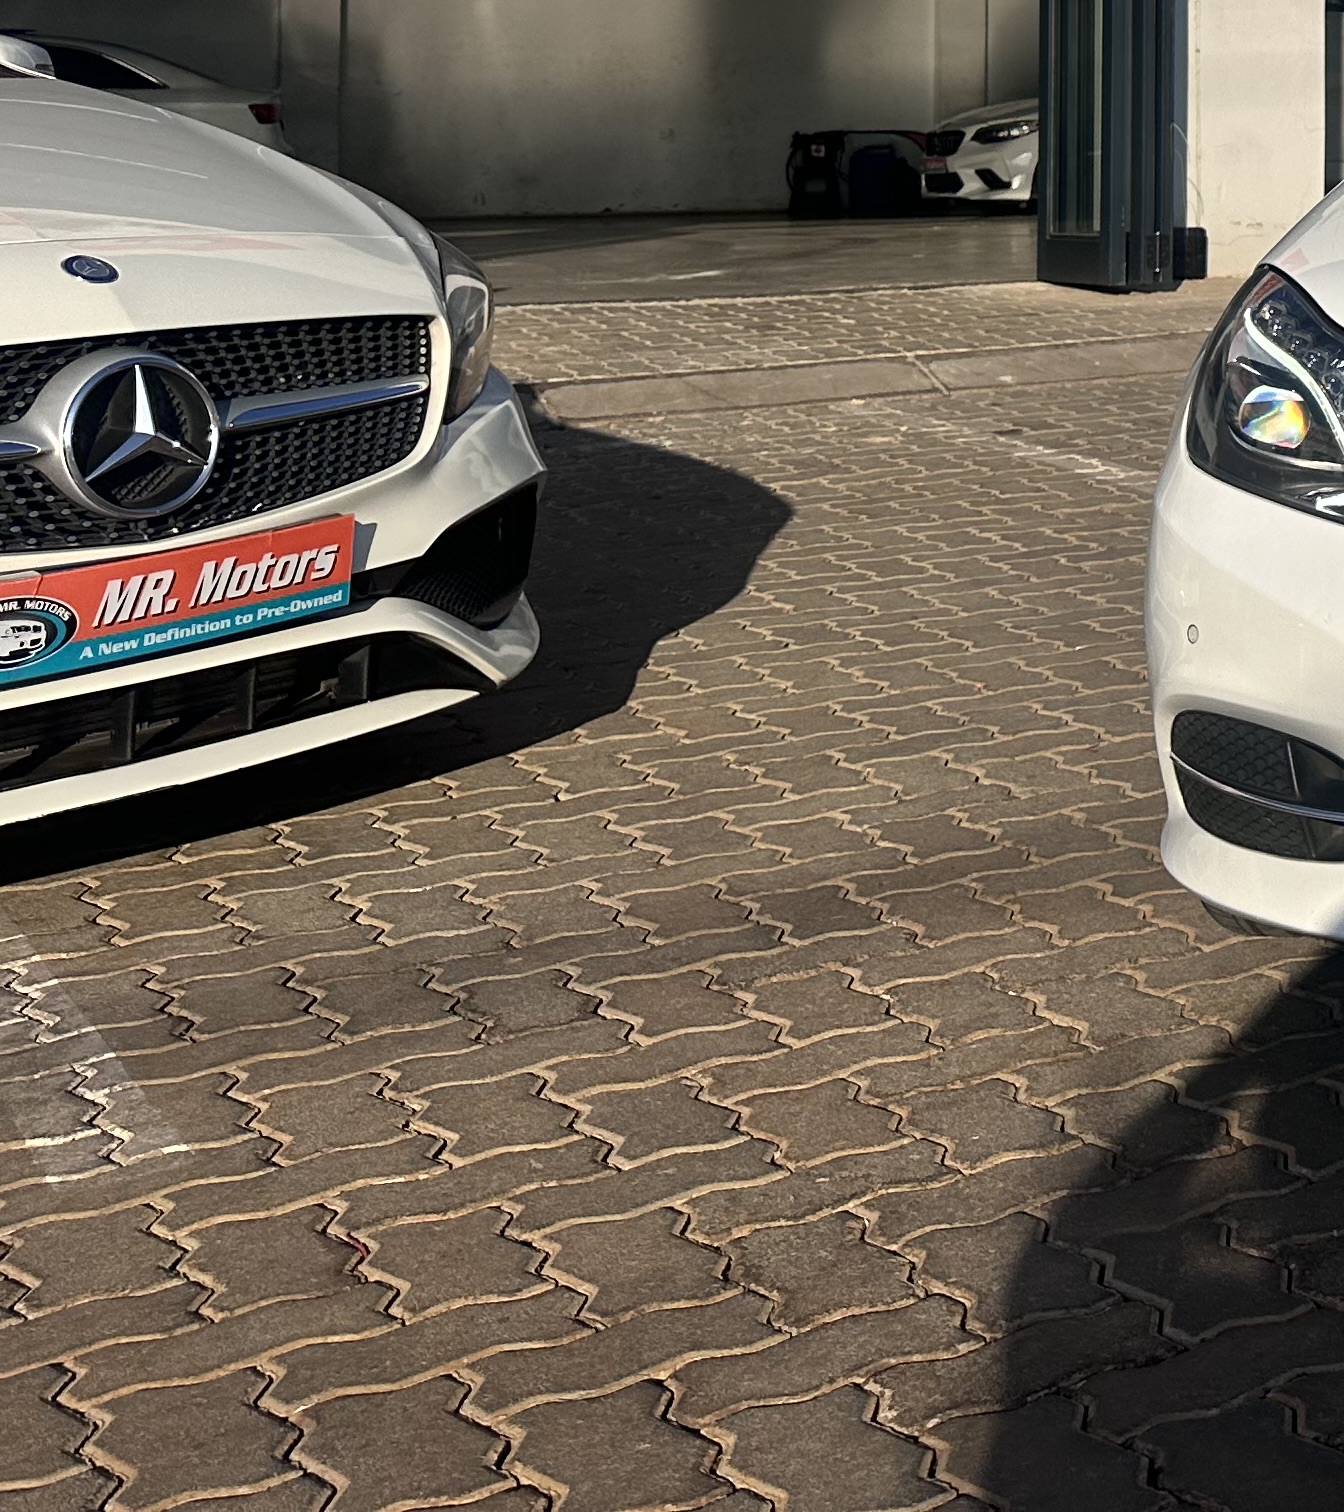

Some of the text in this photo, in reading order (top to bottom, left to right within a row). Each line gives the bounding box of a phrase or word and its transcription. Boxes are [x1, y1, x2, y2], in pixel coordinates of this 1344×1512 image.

[0, 599, 72, 621] MR. MOTORS
[92, 543, 342, 628] MR. Motors
[79, 589, 345, 660] A New Definition to Pre-Owned
